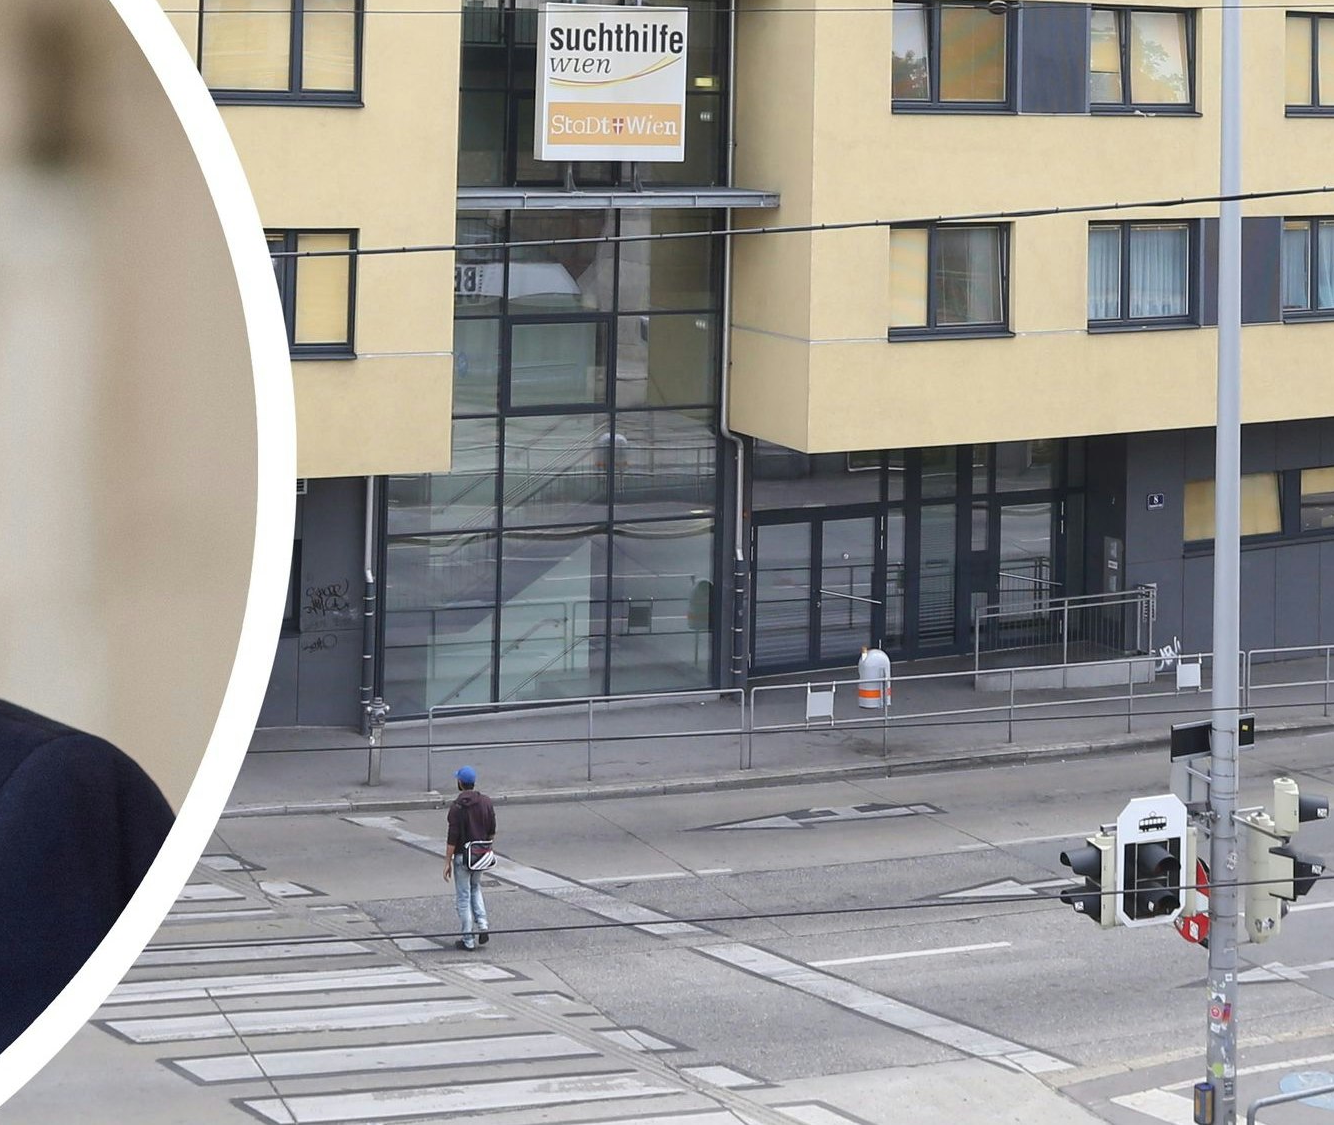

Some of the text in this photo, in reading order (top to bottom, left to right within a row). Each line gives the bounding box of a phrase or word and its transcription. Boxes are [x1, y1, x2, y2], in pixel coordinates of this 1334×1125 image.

[549, 23, 683, 54] suchthilfe
[550, 57, 611, 74] wien
[626, 115, 678, 135] Wien
